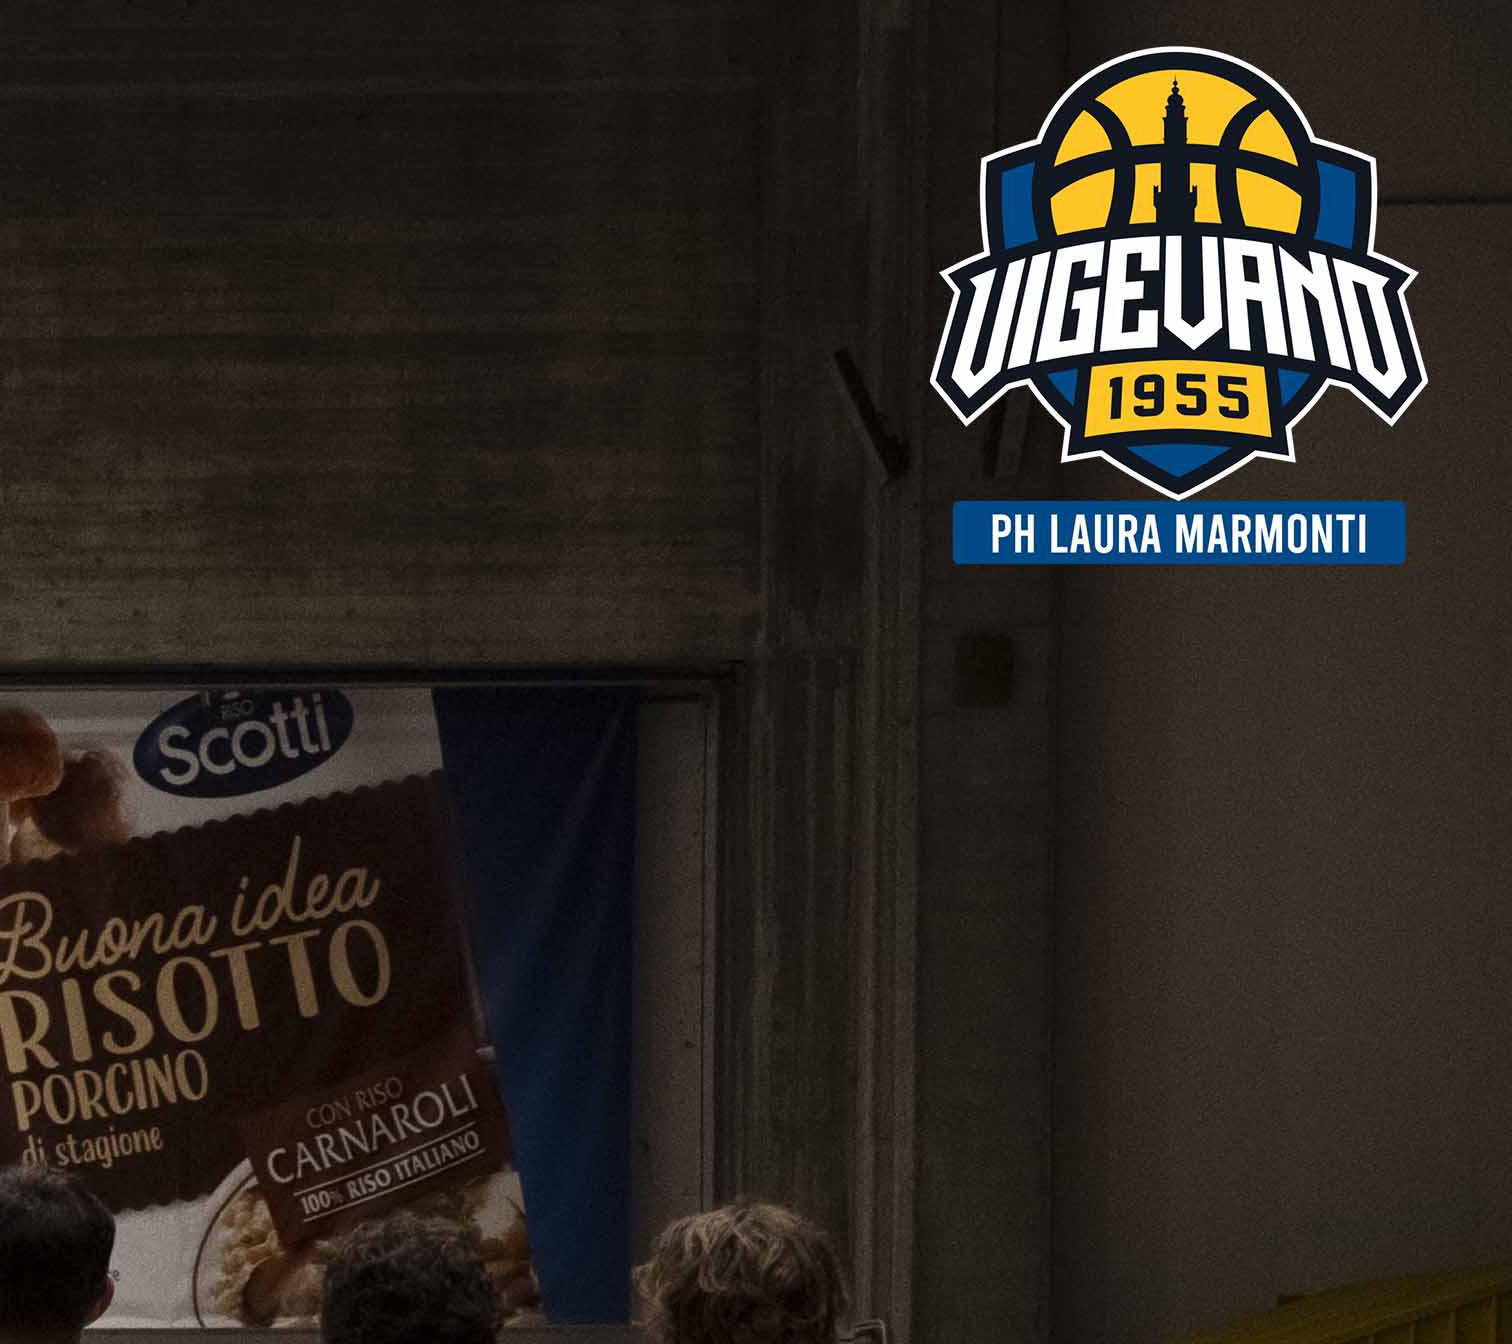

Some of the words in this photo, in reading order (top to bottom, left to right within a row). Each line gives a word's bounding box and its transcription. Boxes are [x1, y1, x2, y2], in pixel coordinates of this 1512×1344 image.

[158, 692, 332, 786] Scotti
[230, 834, 382, 940] idea
[10, 1048, 209, 1132] PORCINO
[266, 1073, 480, 1184] CARNAROLI
[305, 1095, 353, 1129] CON
[355, 1076, 404, 1112] RISO
[22, 1135, 48, 1170] di
[55, 1125, 164, 1169] stagione
[300, 1189, 345, 1216] 100%
[346, 1167, 392, 1200] RISO
[394, 1130, 481, 1182] ITALIANO
